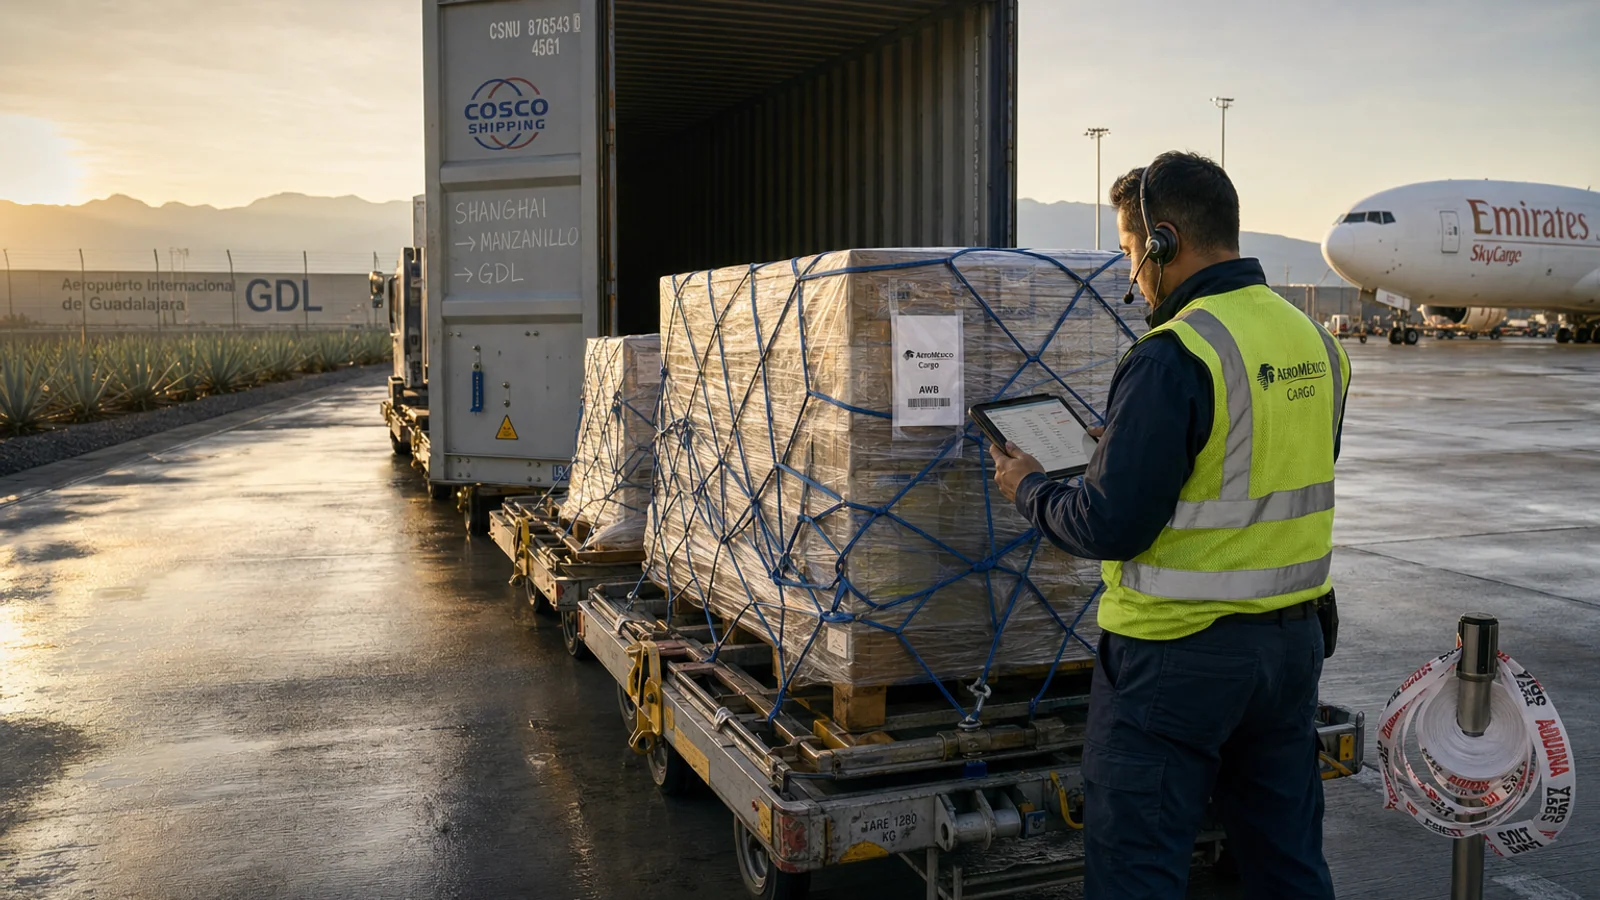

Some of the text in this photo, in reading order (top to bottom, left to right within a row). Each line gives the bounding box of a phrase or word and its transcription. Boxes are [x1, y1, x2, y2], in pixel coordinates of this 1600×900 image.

[489, 20, 521, 40] CSNU
[528, 15, 570, 36] 876543
[531, 38, 560, 57] 45G1
[464, 98, 549, 121] COSCO
[468, 119, 546, 135] SHIPPING
[455, 197, 547, 225] SHANGHAI
[1466, 198, 1589, 241] Emirates
[480, 227, 579, 252] MANZANILLO
[478, 262, 524, 285] GDL
[61, 277, 235, 294] Aeropuerto Internacional
[245, 278, 322, 312] GDL
[61, 296, 185, 313] de Guadalajara
[918, 361, 939, 370] Cargo
[918, 385, 939, 394] AWB
[863, 812, 917, 832] TARE 1280
[882, 830, 896, 842] KG
